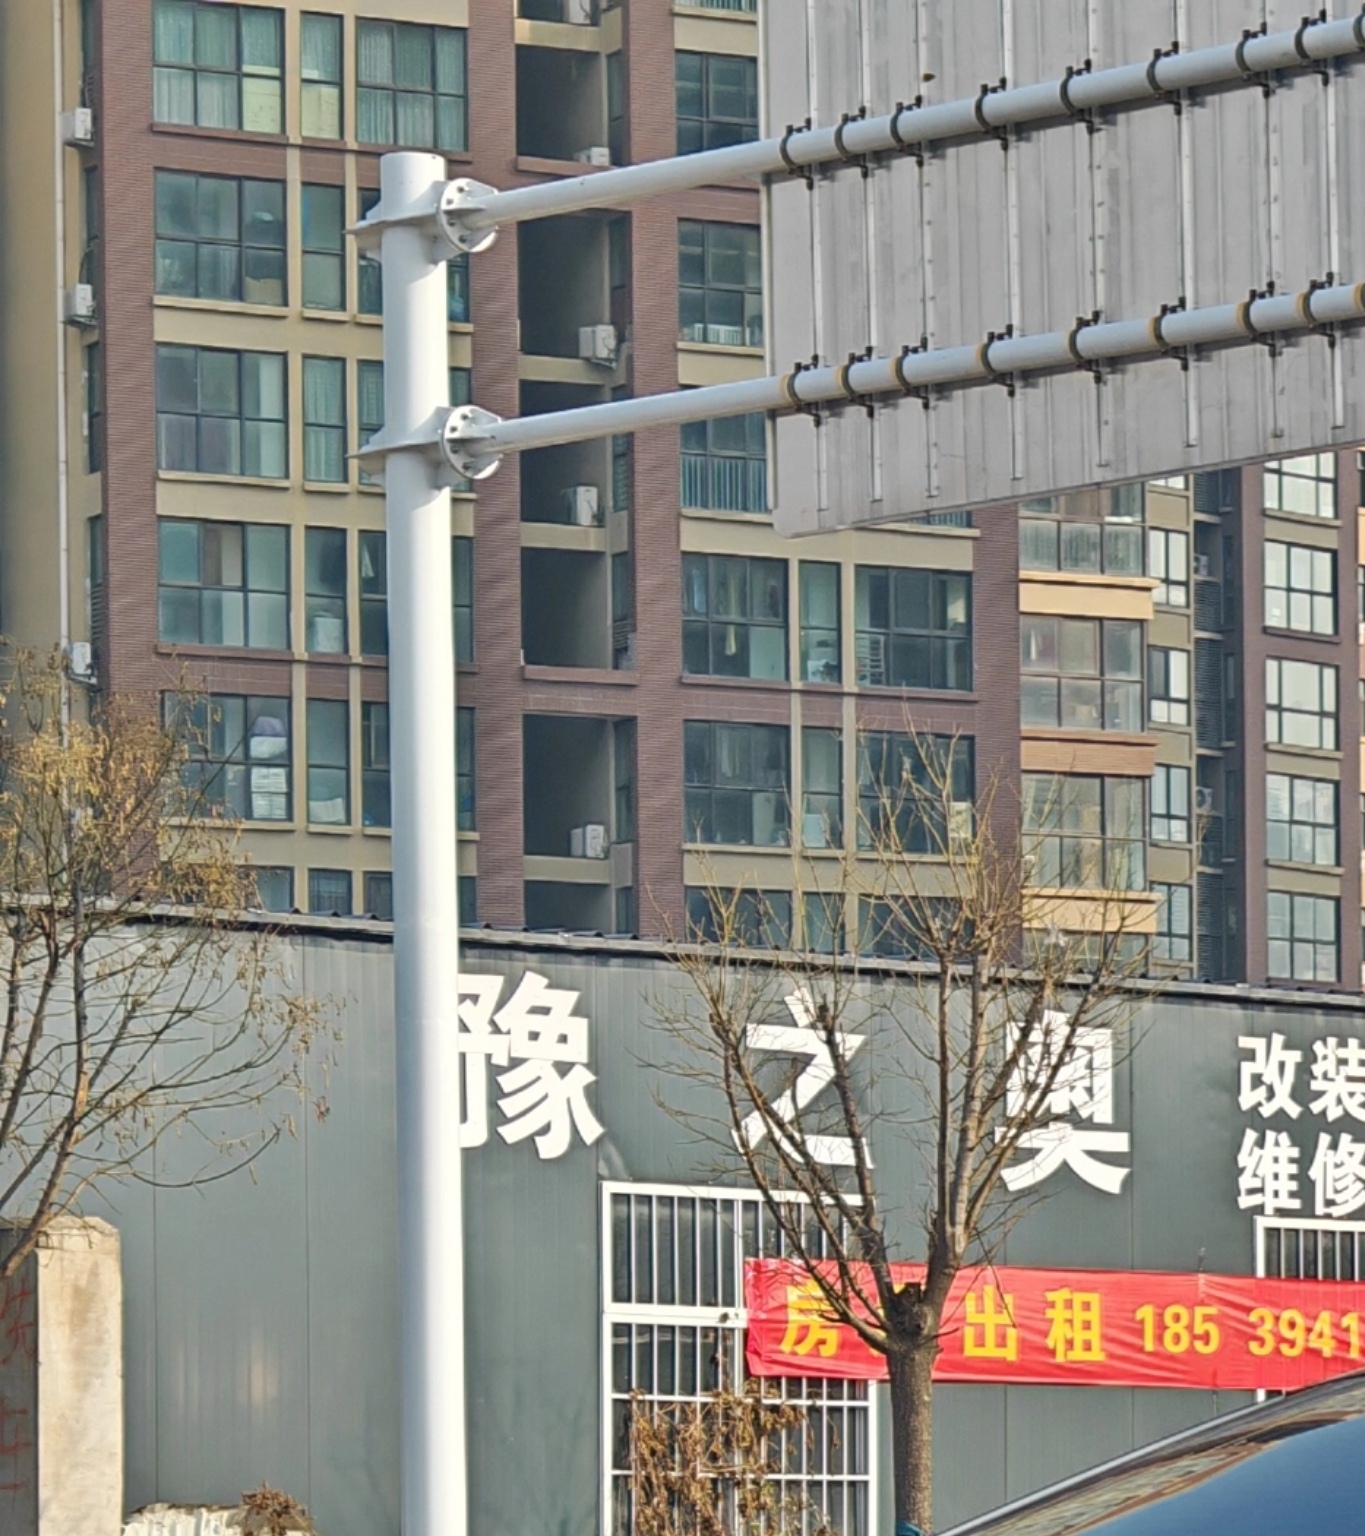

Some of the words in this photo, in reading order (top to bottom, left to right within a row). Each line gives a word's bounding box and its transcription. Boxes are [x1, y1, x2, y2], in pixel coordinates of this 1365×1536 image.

[780, 1273, 1106, 1363] 房出租
[1135, 1304, 1222, 1354] 185
[1247, 1307, 1362, 1358] 3941
